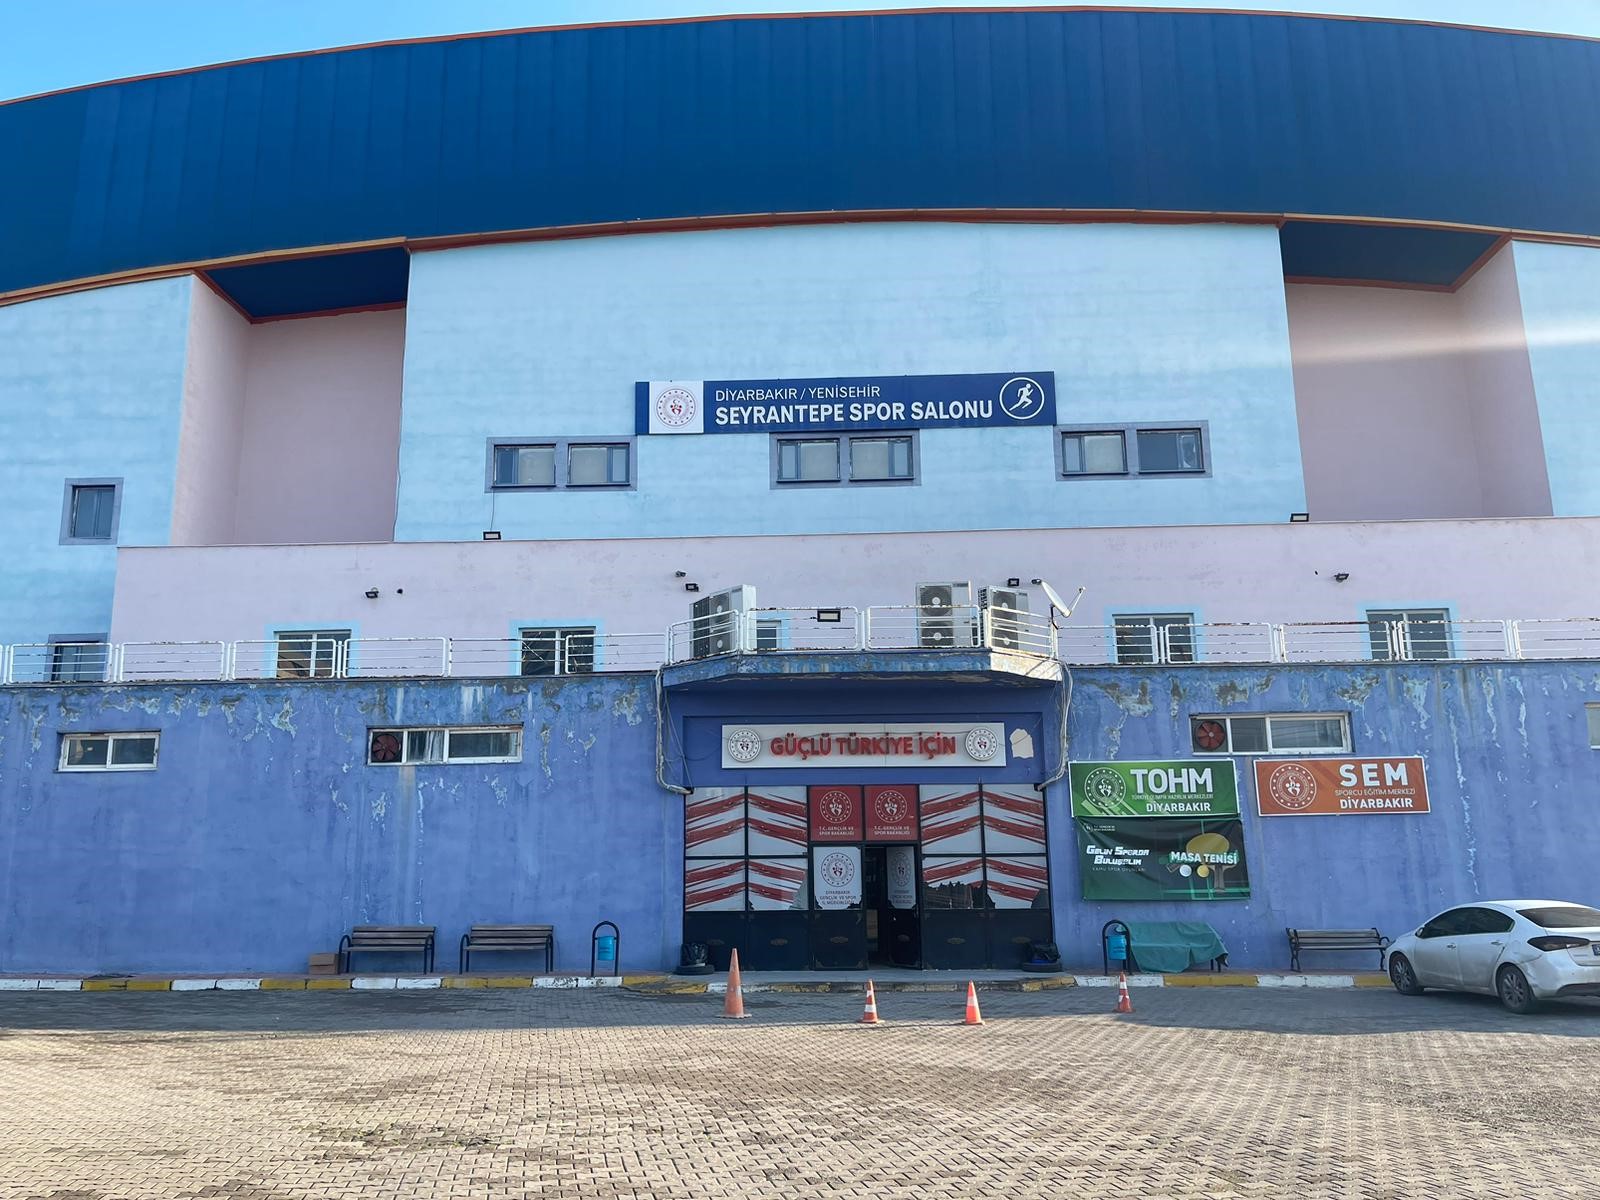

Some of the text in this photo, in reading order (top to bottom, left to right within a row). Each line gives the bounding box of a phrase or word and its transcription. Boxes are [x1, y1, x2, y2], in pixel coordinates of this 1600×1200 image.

[715, 388, 798, 402] DİYARBAKIR
[800, 388, 806, 400] /
[715, 400, 993, 426] SEYRANTEPE SPOR SALONU
[770, 732, 832, 760] GÜÇLÜ
[836, 731, 914, 756] TÜRKİYE
[918, 731, 957, 760] İÇİN
[1129, 767, 1214, 794] TOHM
[1339, 762, 1409, 787] SEM
[1335, 788, 1363, 797] SPORCU
[1146, 802, 1212, 813] DİYARBAKIR
[1340, 796, 1414, 809] DİYARBAKIR
[1170, 850, 1238, 865] MASA TENİSİ
